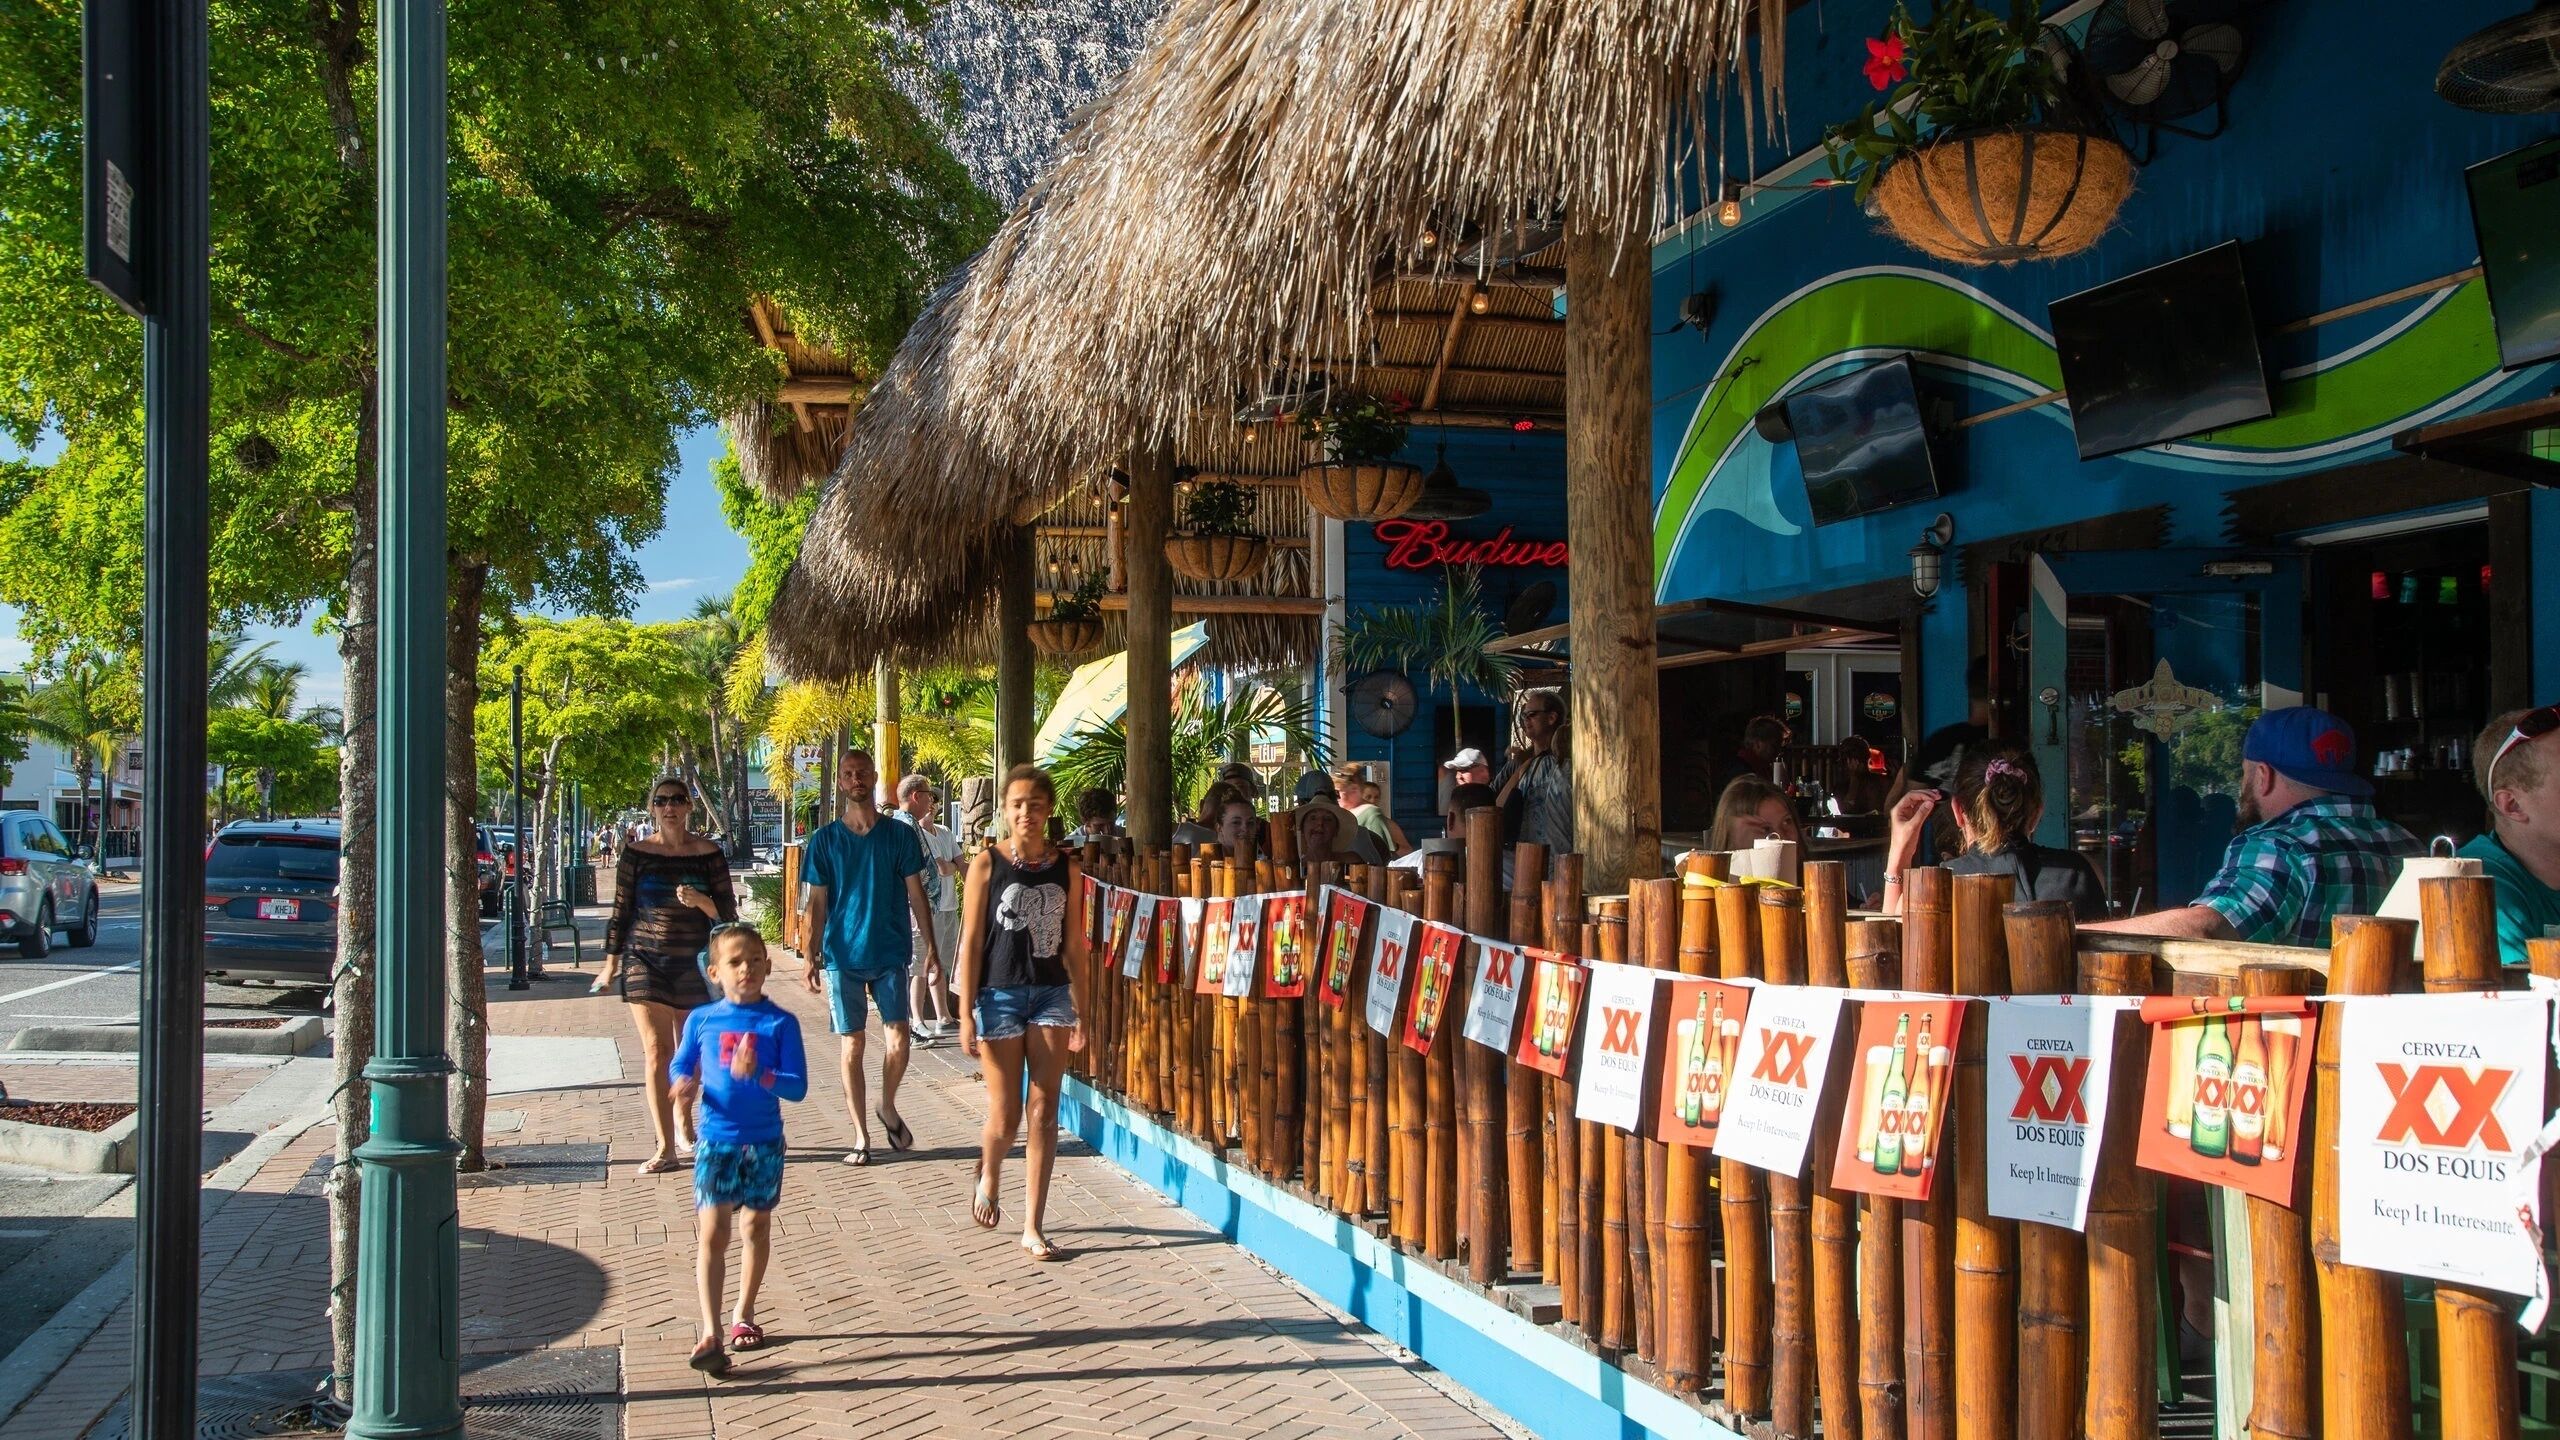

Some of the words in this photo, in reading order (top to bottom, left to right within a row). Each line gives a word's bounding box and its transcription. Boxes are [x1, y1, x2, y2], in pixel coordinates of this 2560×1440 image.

[1375, 519, 1570, 570] Budwe
[244, 885, 316, 894] VOLVO
[1377, 939, 1403, 980] XX
[1485, 947, 1515, 988] XX
[1484, 985, 1495, 996] DOS
[1600, 1007, 1642, 1056] XX
[1773, 1015, 1806, 1029] CERVEZA
[2027, 1038, 2074, 1052] CERVEZA
[2402, 1041, 2481, 1059] CERVEZA
[1601, 1055, 1616, 1068] DOS
[1618, 1058, 1637, 1072] EQUIS
[1751, 1028, 1817, 1089] XX
[1703, 1074, 1722, 1093] XX
[2009, 1055, 2094, 1124] XX
[2194, 1074, 2230, 1109] XX
[1750, 1085, 1769, 1100] DOS
[1771, 1089, 1804, 1108] EQUIS
[2230, 1081, 2267, 1116] XX
[2375, 1062, 2514, 1153] XX
[1737, 1115, 1756, 1131] Keep
[1879, 1110, 1904, 1134] XX
[1905, 1111, 1928, 1135] XX
[2016, 1125, 2045, 1143] DOS
[2049, 1128, 2085, 1147] EQUIS
[2010, 1163, 2034, 1184] Keep
[2037, 1166, 2045, 1181] It
[2383, 1150, 2429, 1174] DOS
[2437, 1155, 2507, 1182] EQUIS
[2373, 1199, 2411, 1226] Keep
[2414, 1202, 2430, 1222] It
